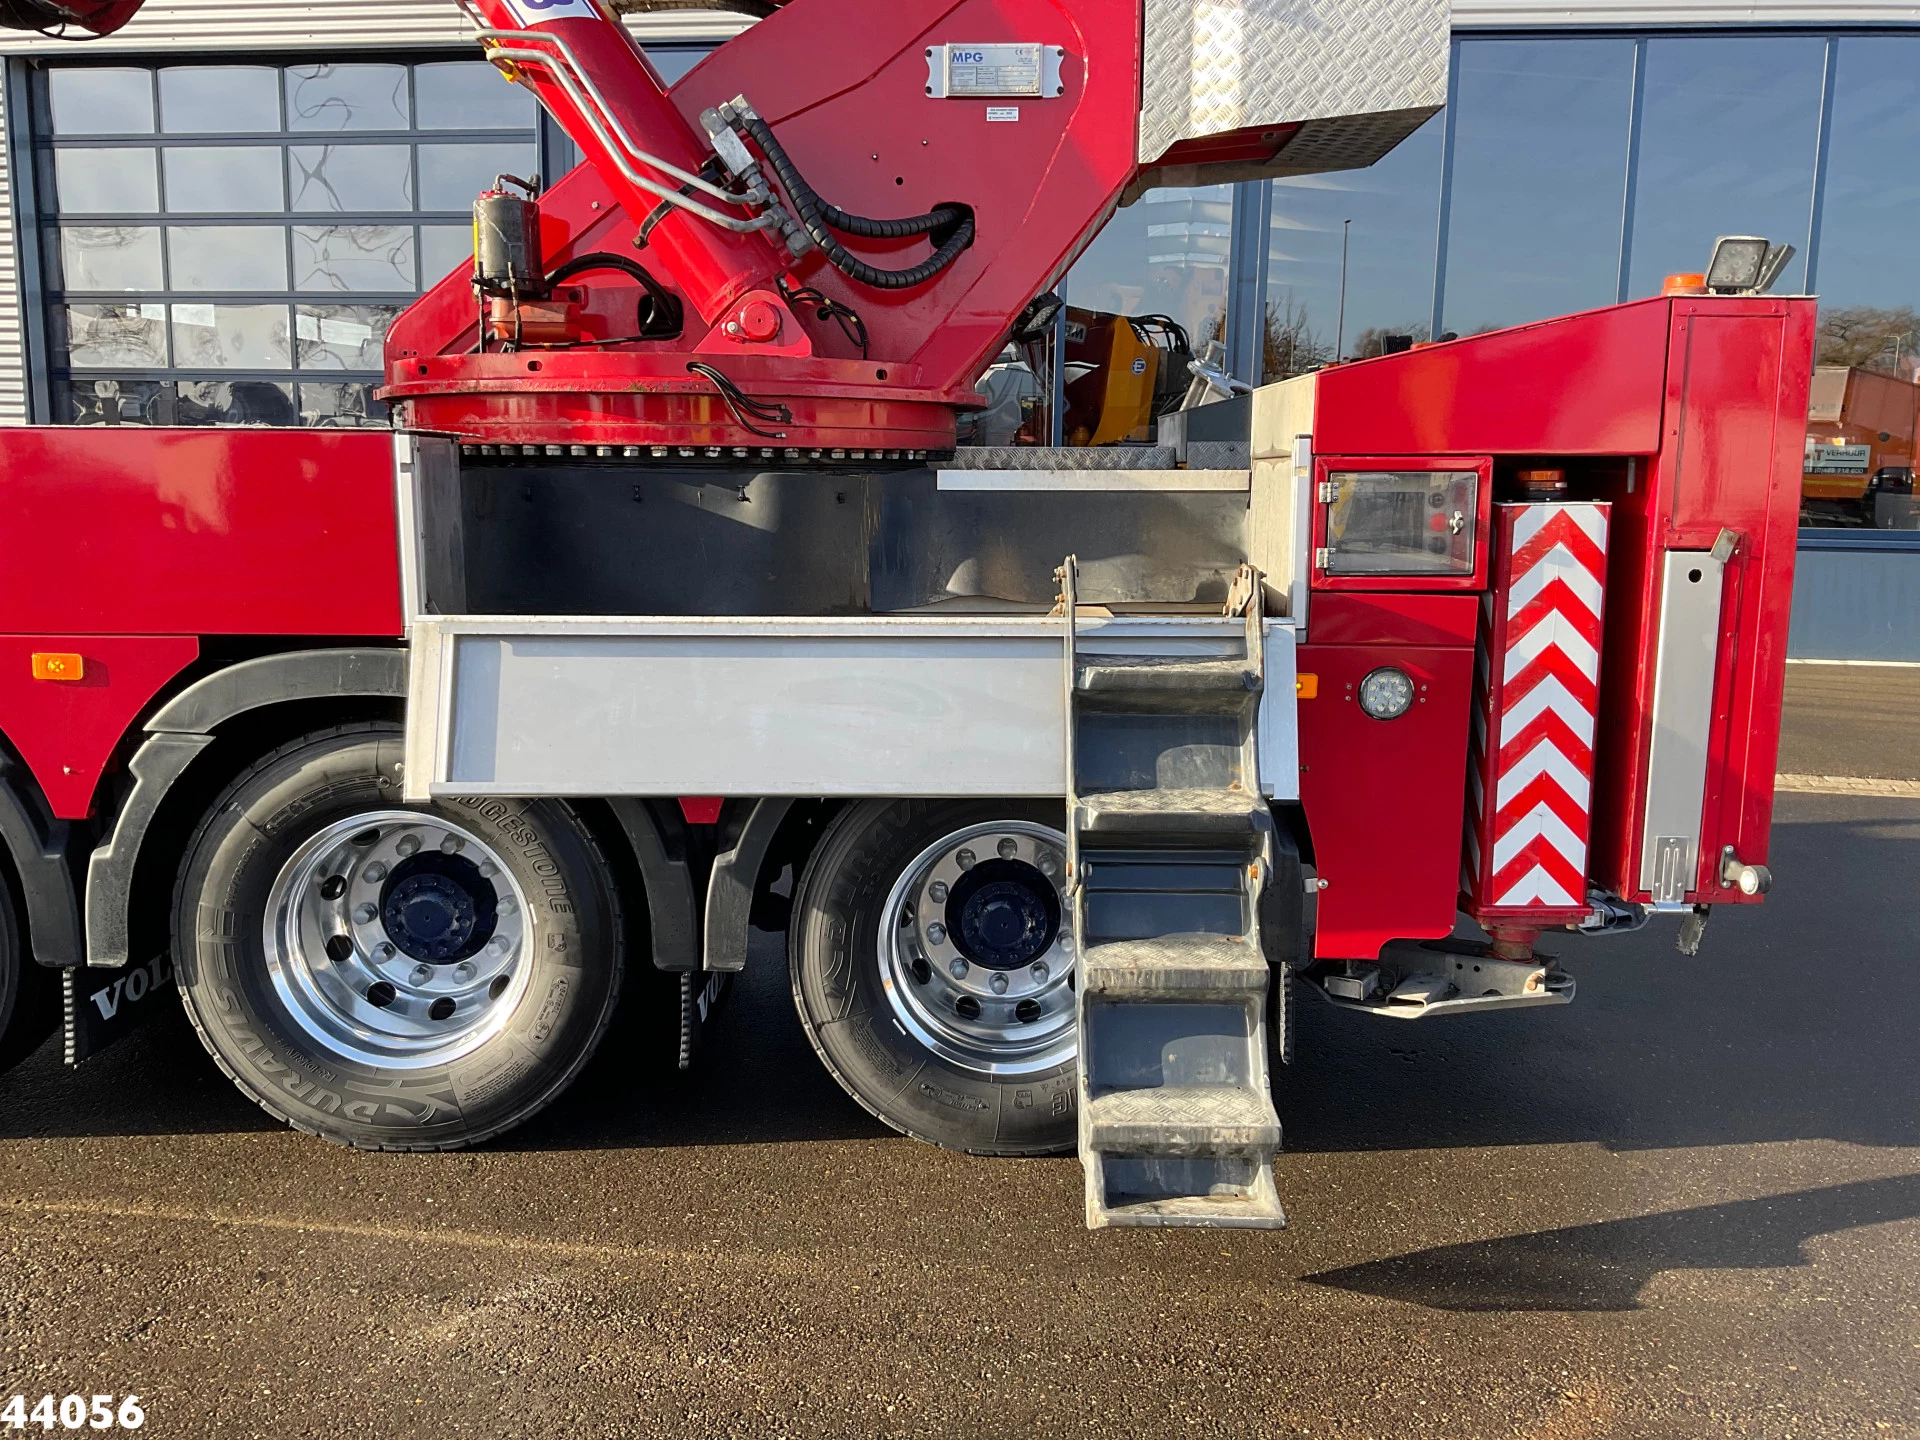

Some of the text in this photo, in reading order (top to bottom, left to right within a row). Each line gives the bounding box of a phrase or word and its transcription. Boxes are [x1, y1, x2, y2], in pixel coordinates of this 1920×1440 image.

[952, 52, 983, 62] MPG
[90, 949, 173, 1021] VOL
[214, 985, 380, 1124] DURAVIS
